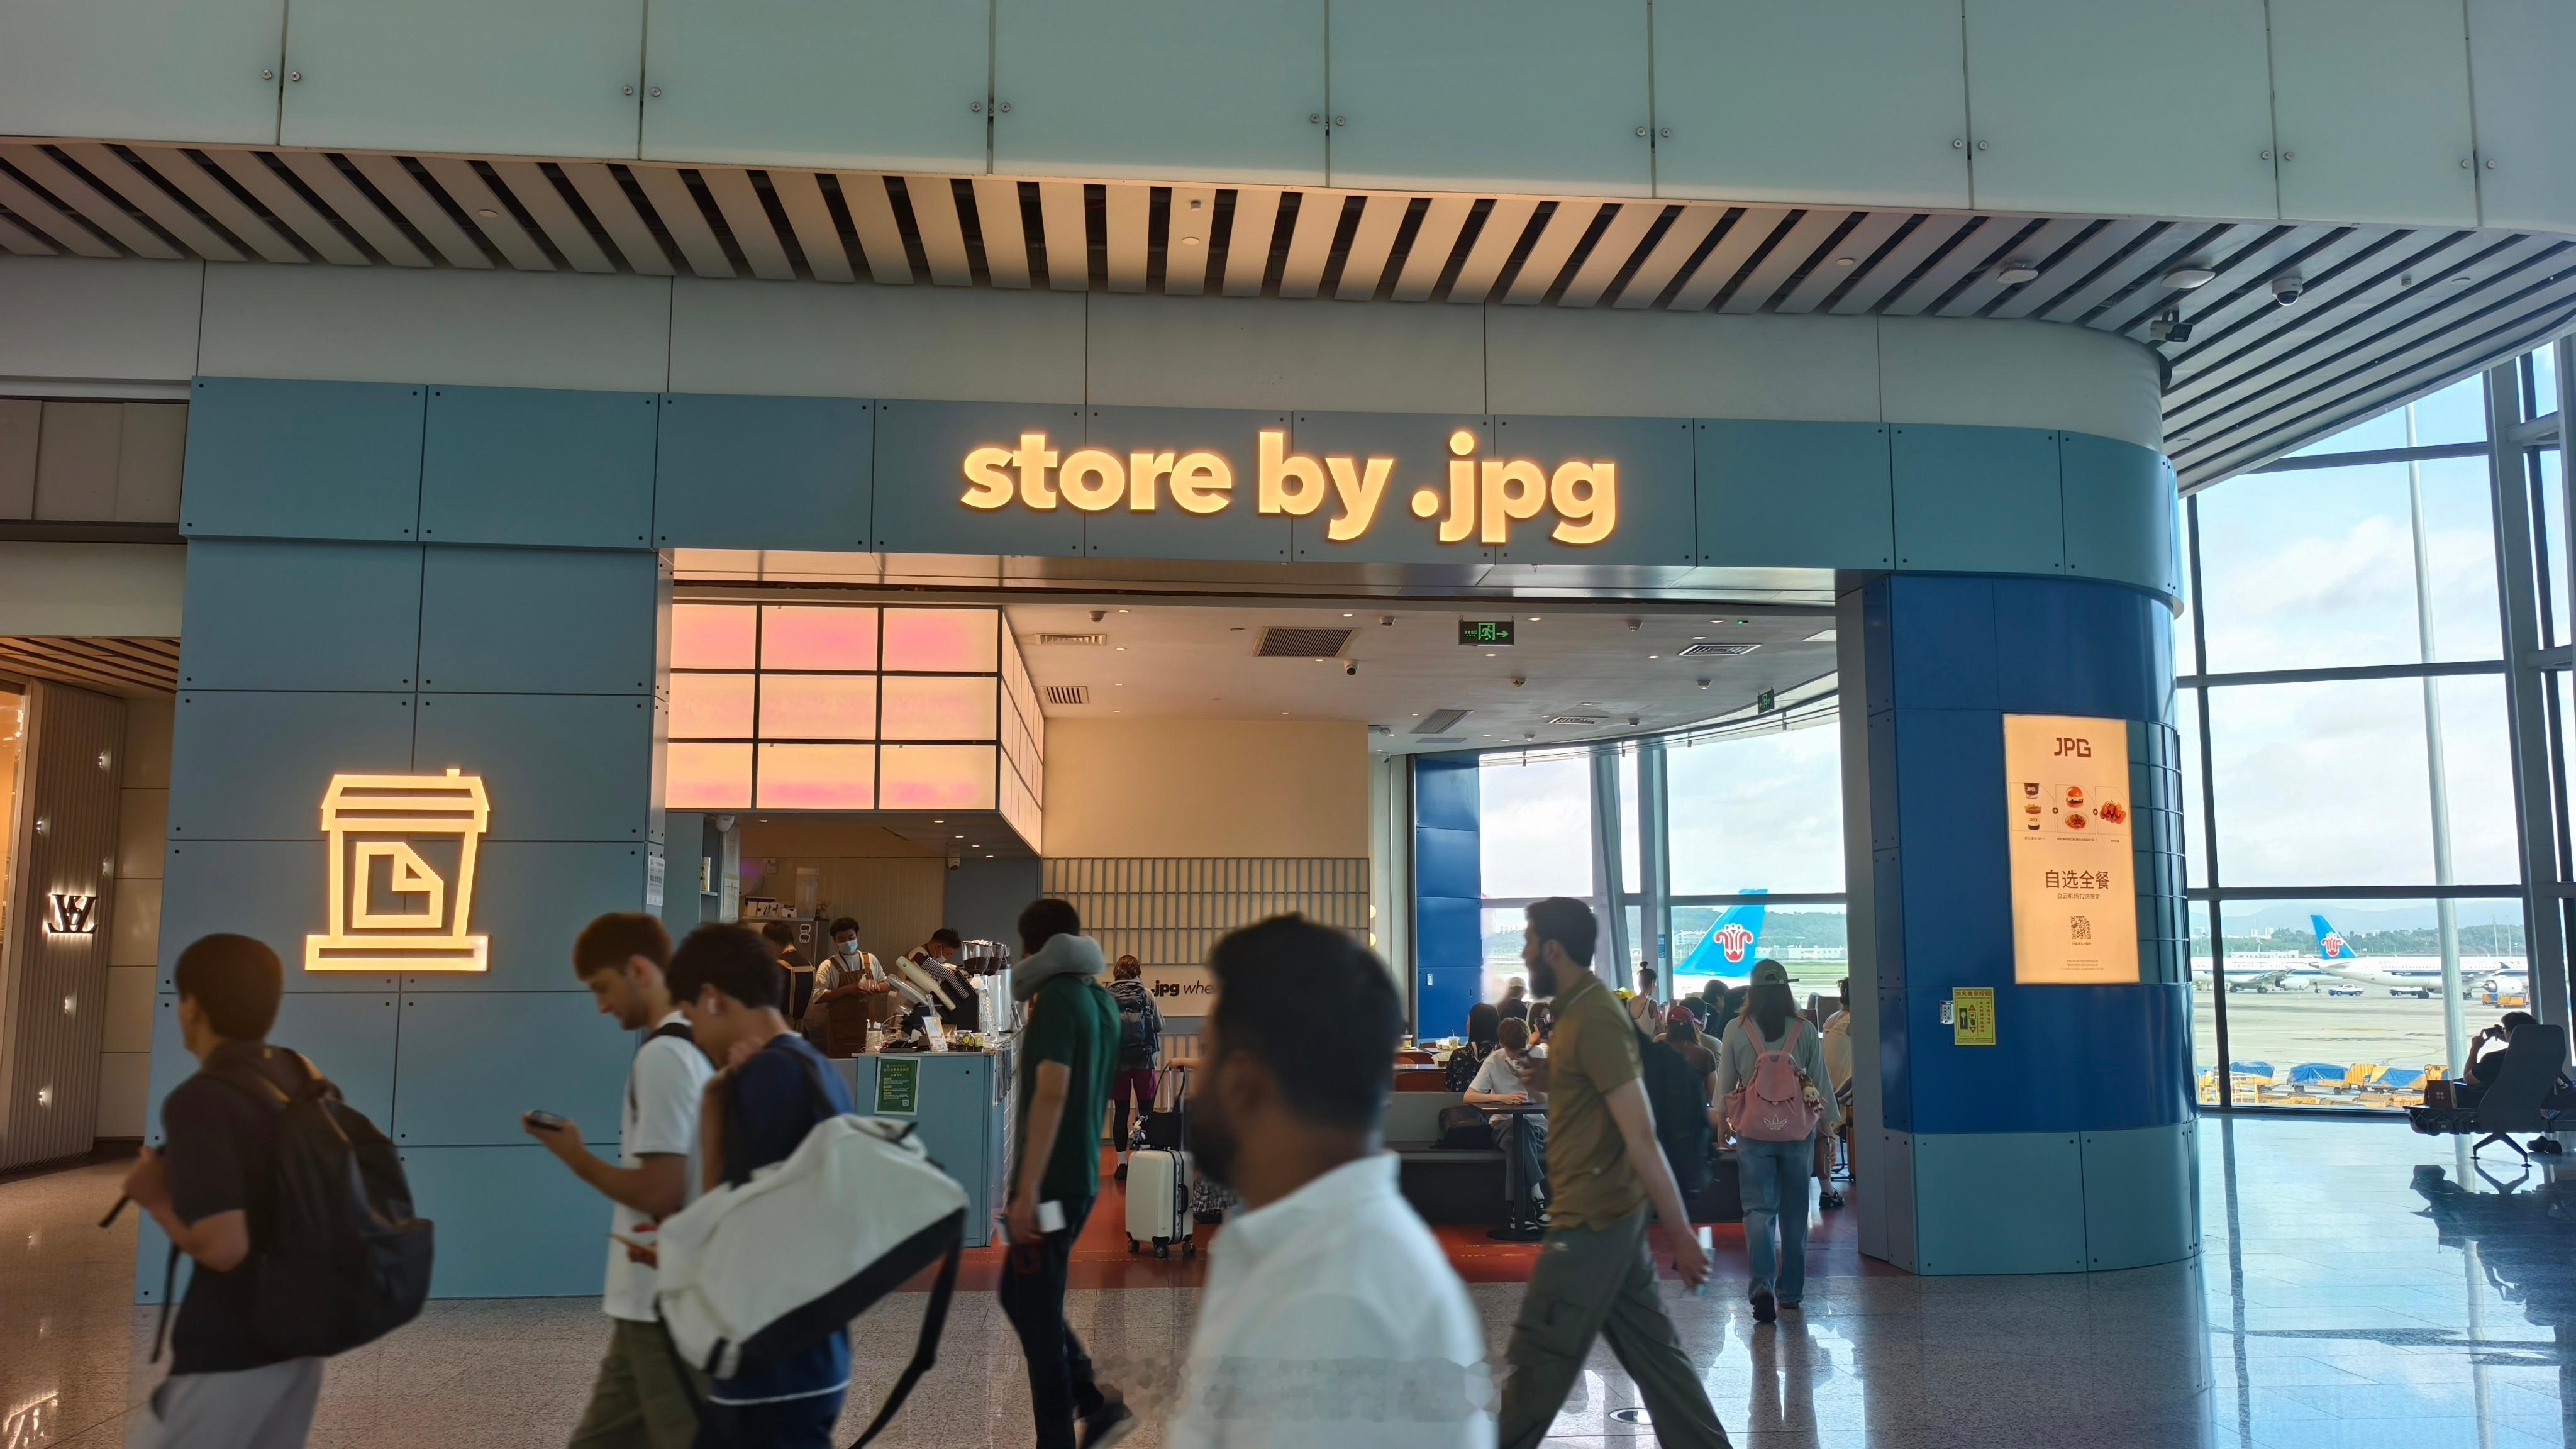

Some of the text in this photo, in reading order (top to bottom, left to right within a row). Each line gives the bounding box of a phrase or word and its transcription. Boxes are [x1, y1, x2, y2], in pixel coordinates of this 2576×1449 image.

[961, 431, 1616, 545] store by .jpg
[2054, 737, 2092, 758] JPG
[2045, 869, 2109, 889] 自选全餐
[1184, 980, 1214, 994] whe
